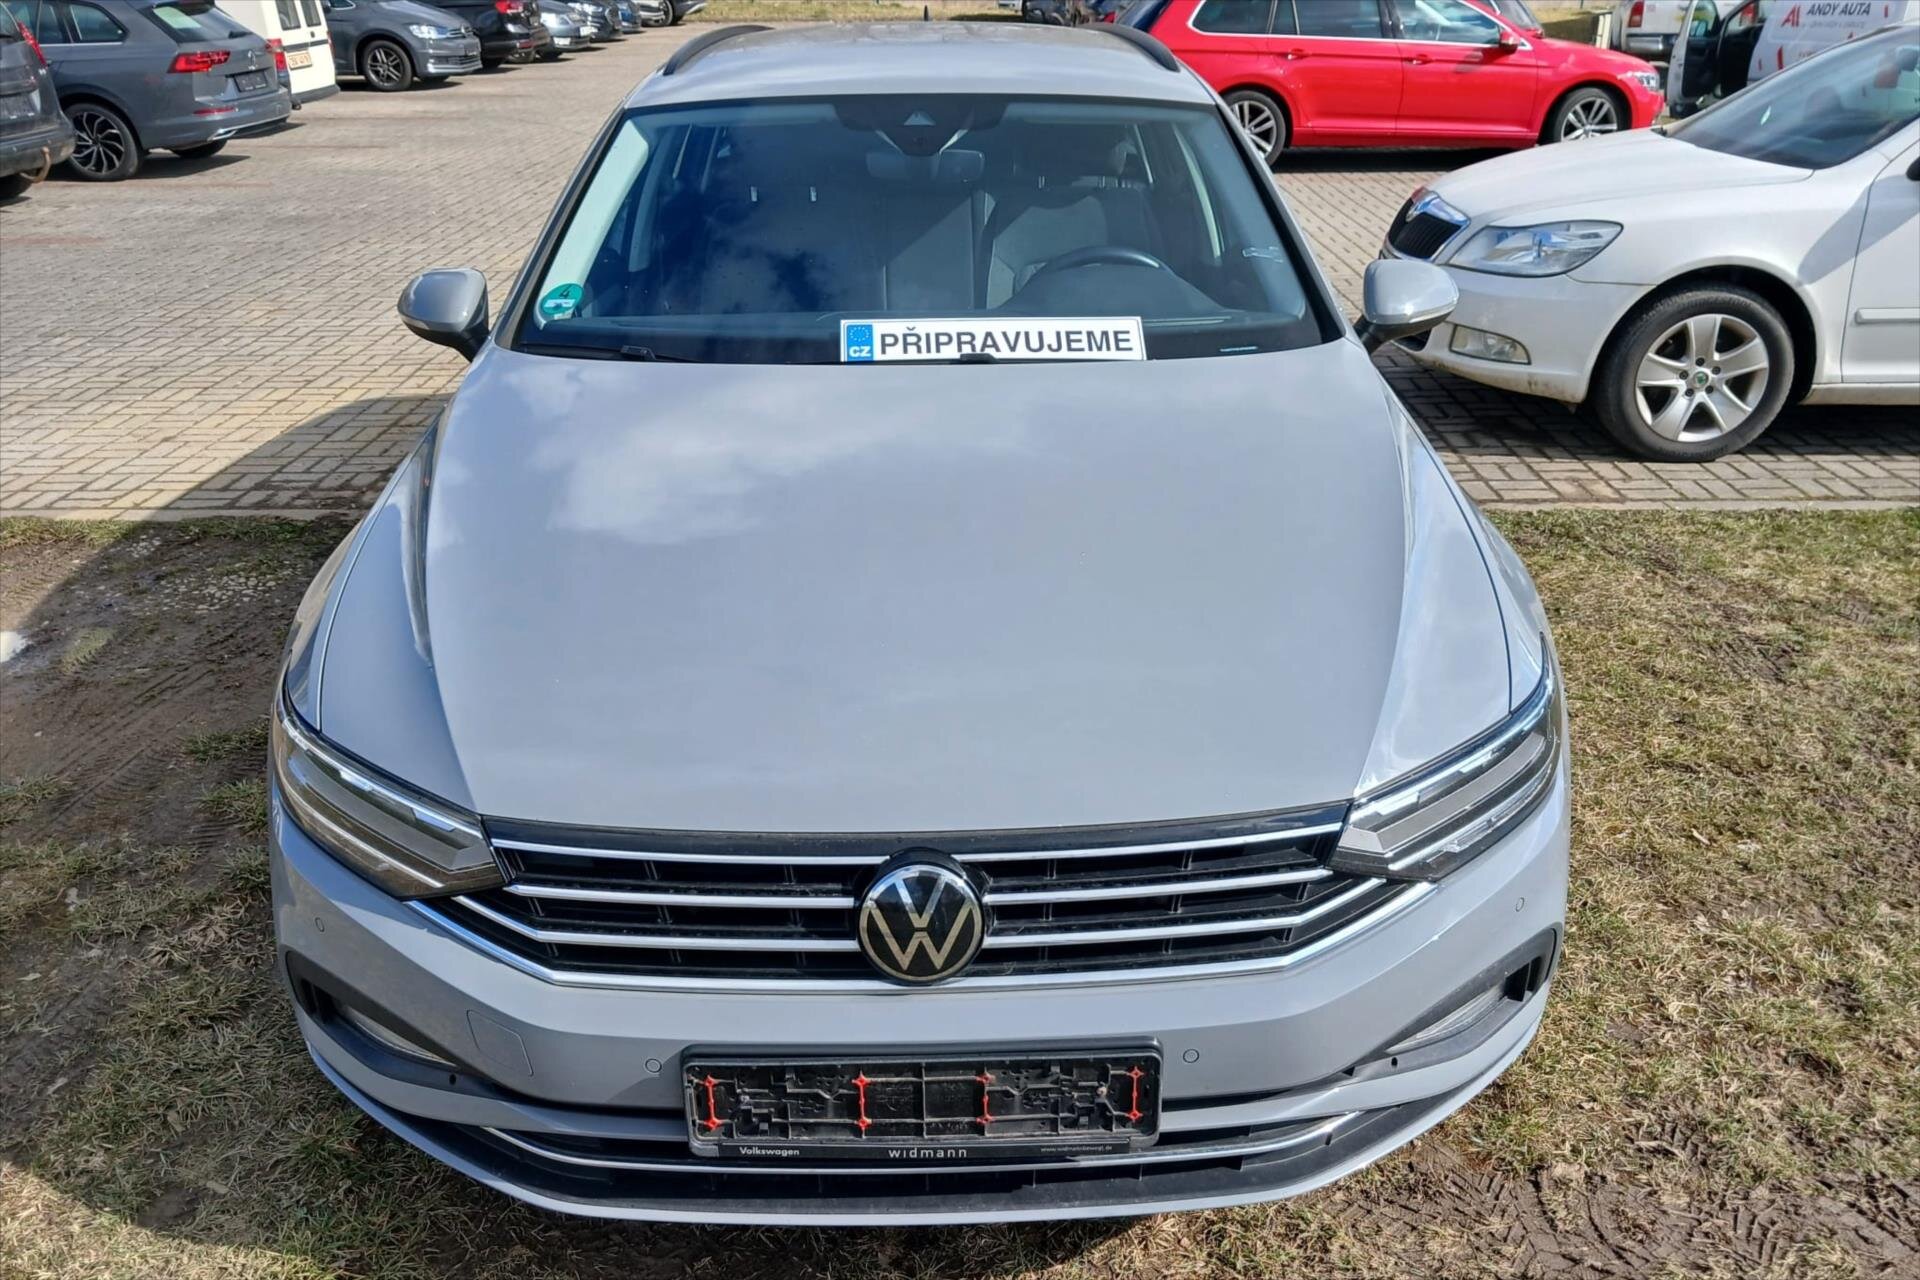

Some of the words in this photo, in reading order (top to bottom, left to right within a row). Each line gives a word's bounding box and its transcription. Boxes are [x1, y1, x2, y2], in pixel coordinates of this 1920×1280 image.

[1807, 3, 1839, 16] ANDY
[1840, 3, 1871, 16] AUTA
[559, 285, 571, 298] 4
[880, 326, 1134, 355] PŘIPRAVUJEME
[849, 345, 871, 358] CZ
[739, 1146, 800, 1156] Volkswagen
[888, 1147, 968, 1159] widmann
